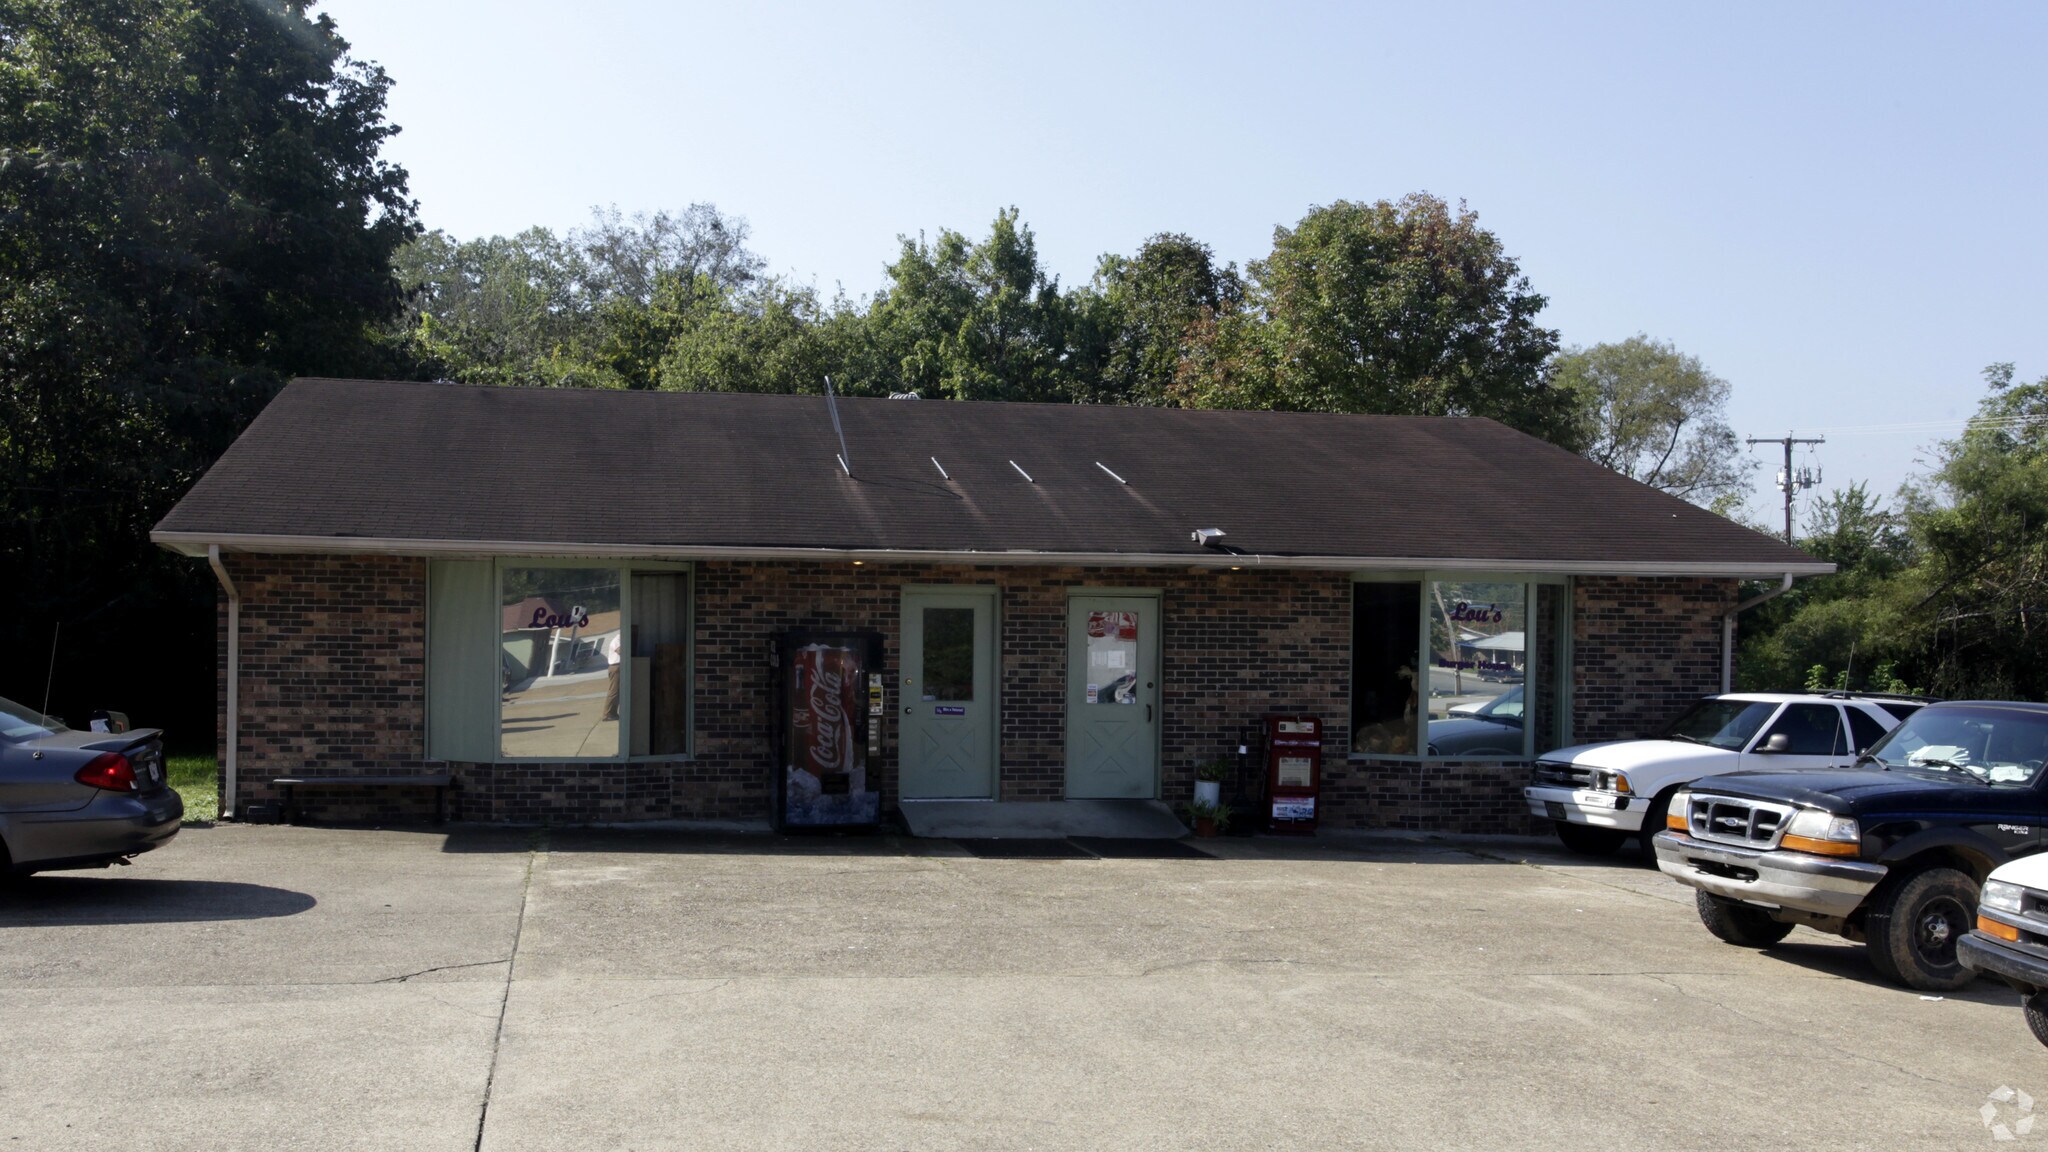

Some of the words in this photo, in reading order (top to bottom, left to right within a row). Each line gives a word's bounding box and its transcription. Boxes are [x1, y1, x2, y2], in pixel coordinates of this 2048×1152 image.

[528, 606, 589, 628] Lou's
[1450, 601, 1502, 623] Lou's
[1439, 659, 1475, 670] Burger
